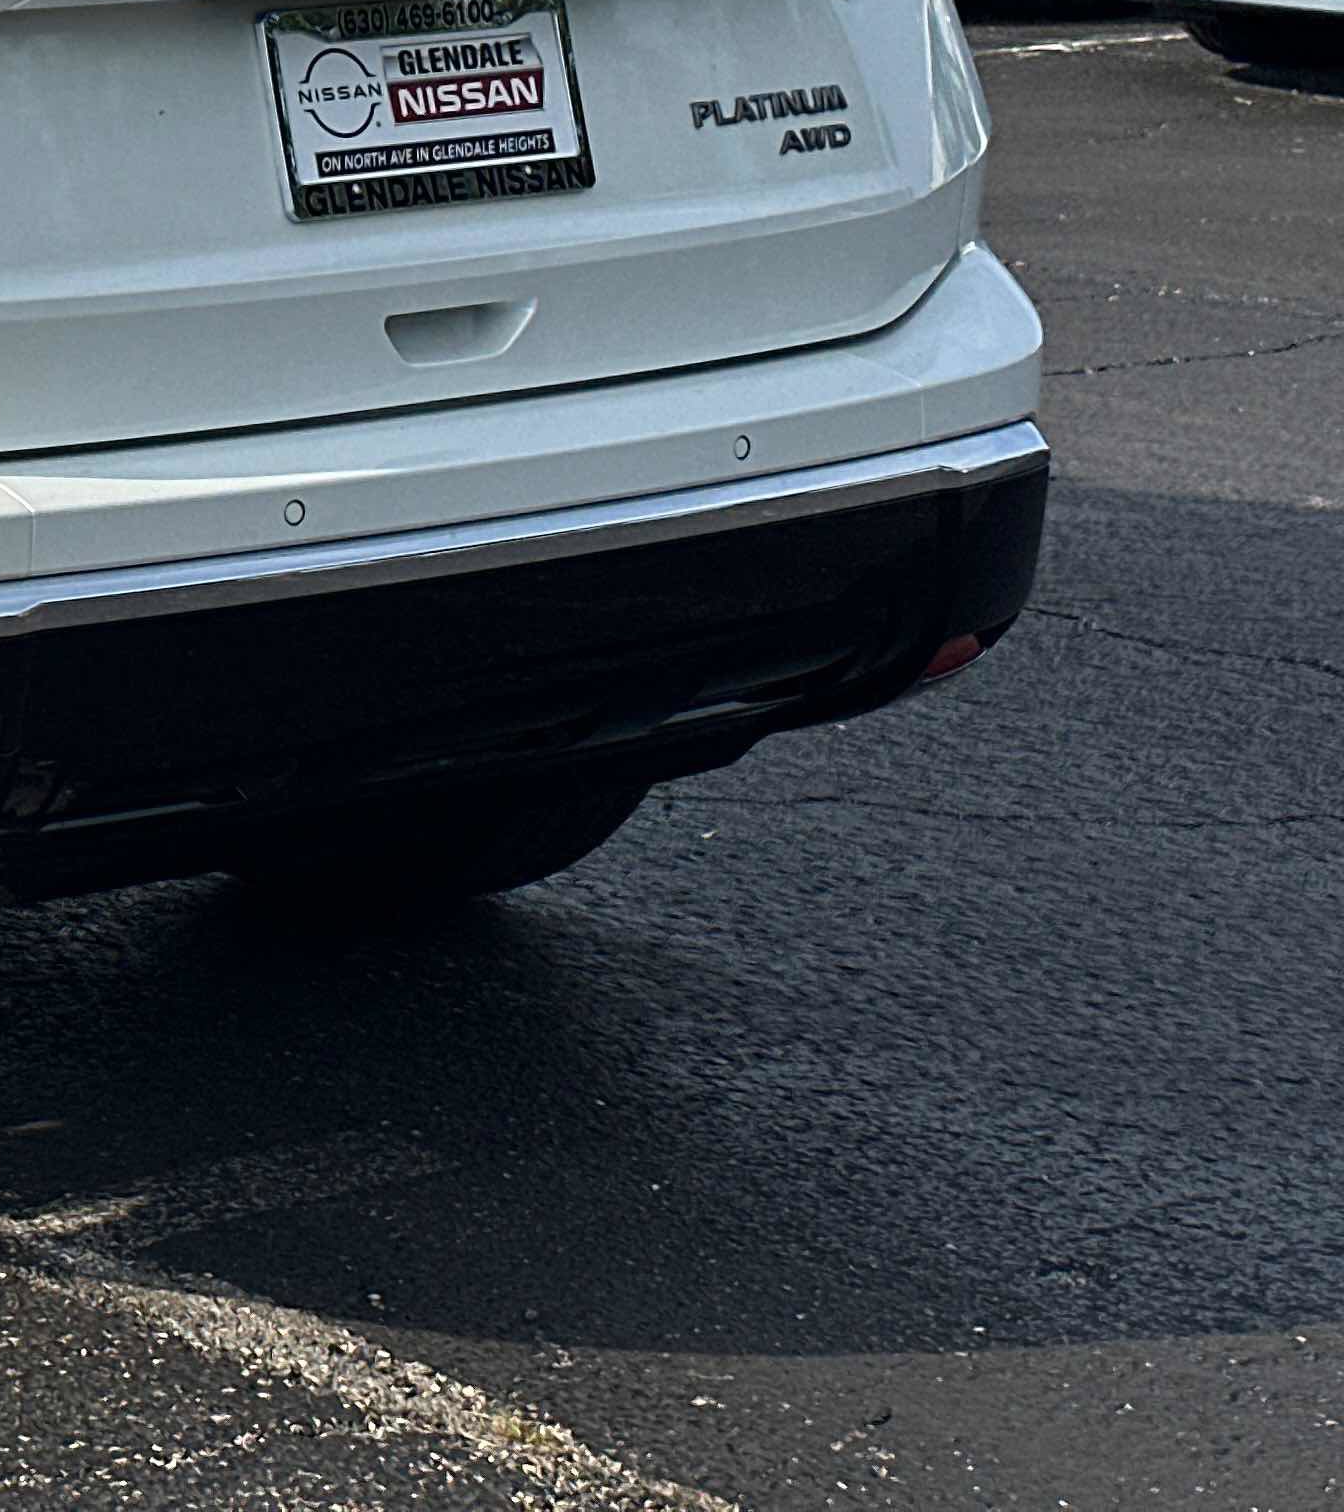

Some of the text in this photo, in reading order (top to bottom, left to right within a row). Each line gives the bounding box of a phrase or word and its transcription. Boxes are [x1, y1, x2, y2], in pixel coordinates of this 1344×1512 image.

[337, 2, 390, 37] (630)
[397, 39, 524, 76] GLENDALE
[297, 80, 385, 105] NISSAN
[397, 75, 540, 119] NISSAN
[689, 84, 849, 129] PLATINUM
[321, 133, 551, 174] ON NORTH AVE IN GLENDALE HEIGHTS
[778, 123, 852, 156] AWD
[304, 157, 588, 218] GLENDALE NISSAN
